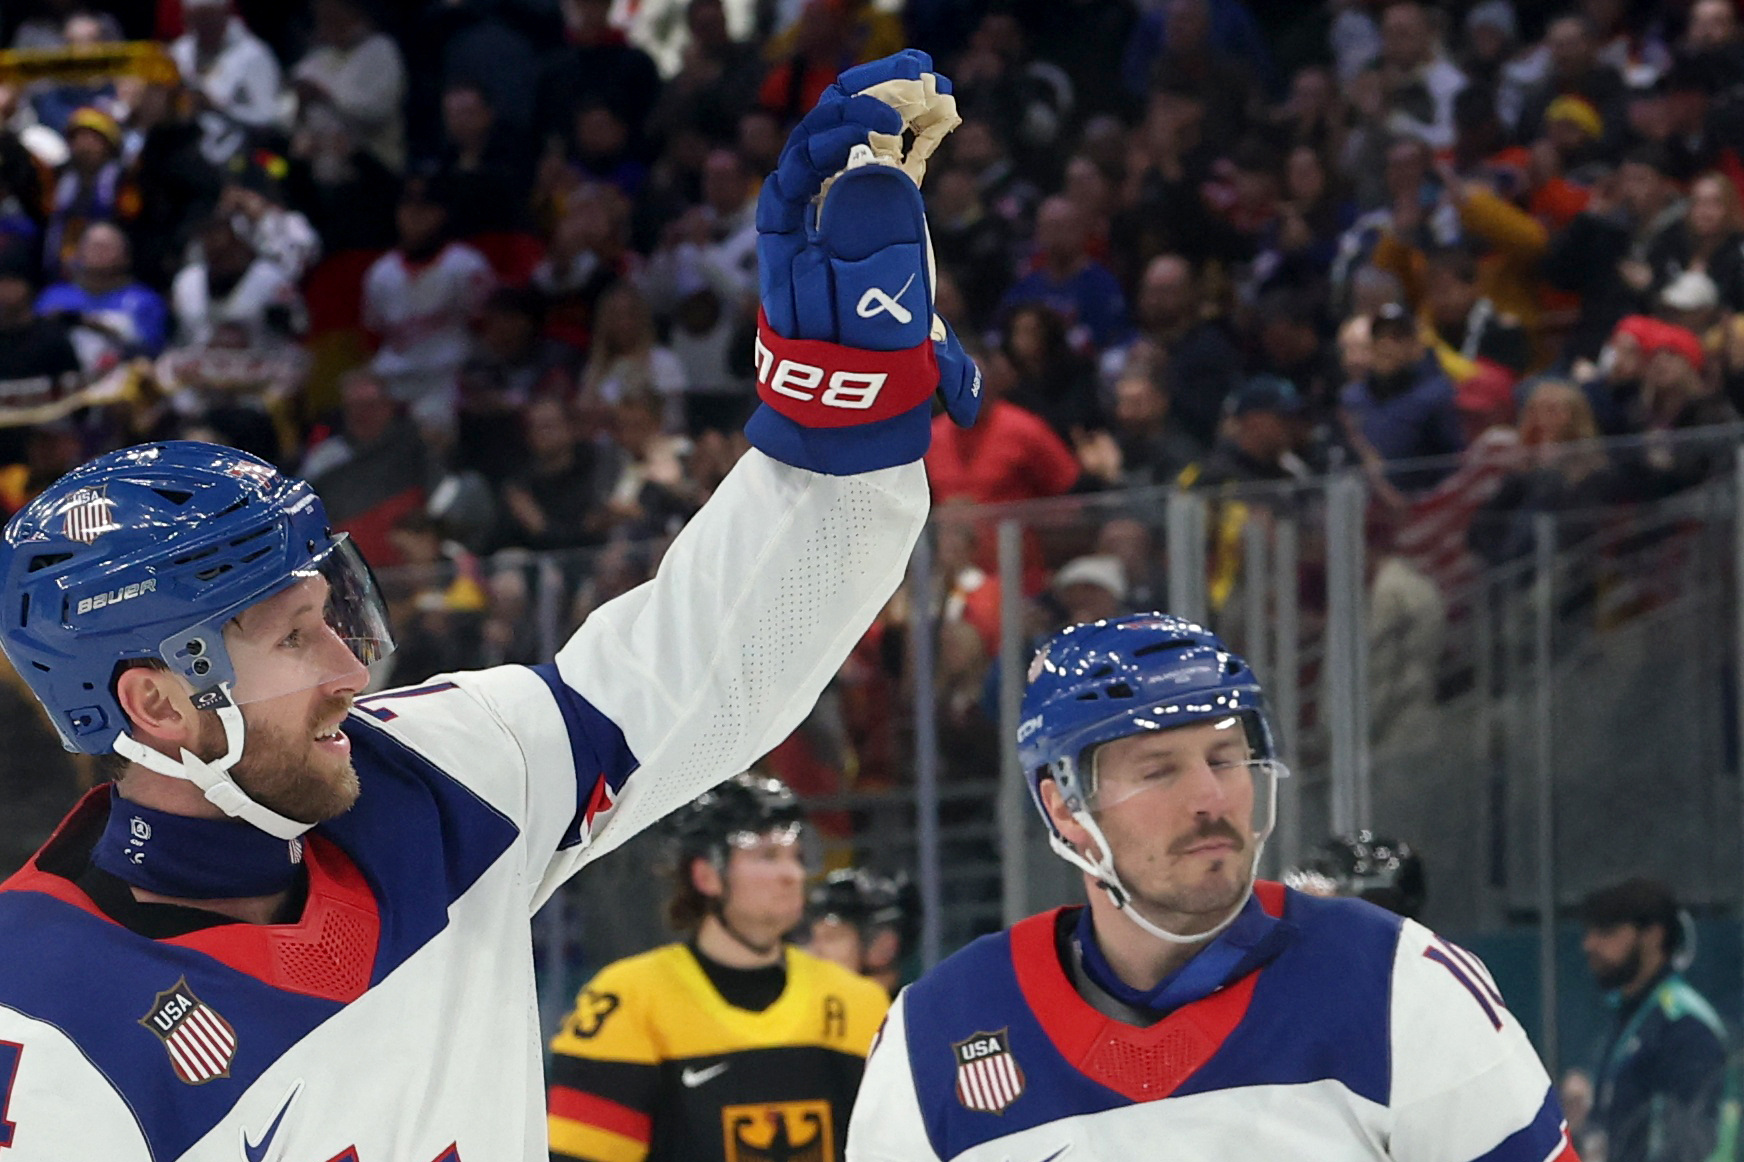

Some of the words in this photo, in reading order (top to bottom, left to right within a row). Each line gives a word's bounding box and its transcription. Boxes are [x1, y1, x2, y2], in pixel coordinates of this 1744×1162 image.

[154, 993, 192, 1031] USA
[823, 996, 848, 1038] A
[961, 1037, 1002, 1061] USA
